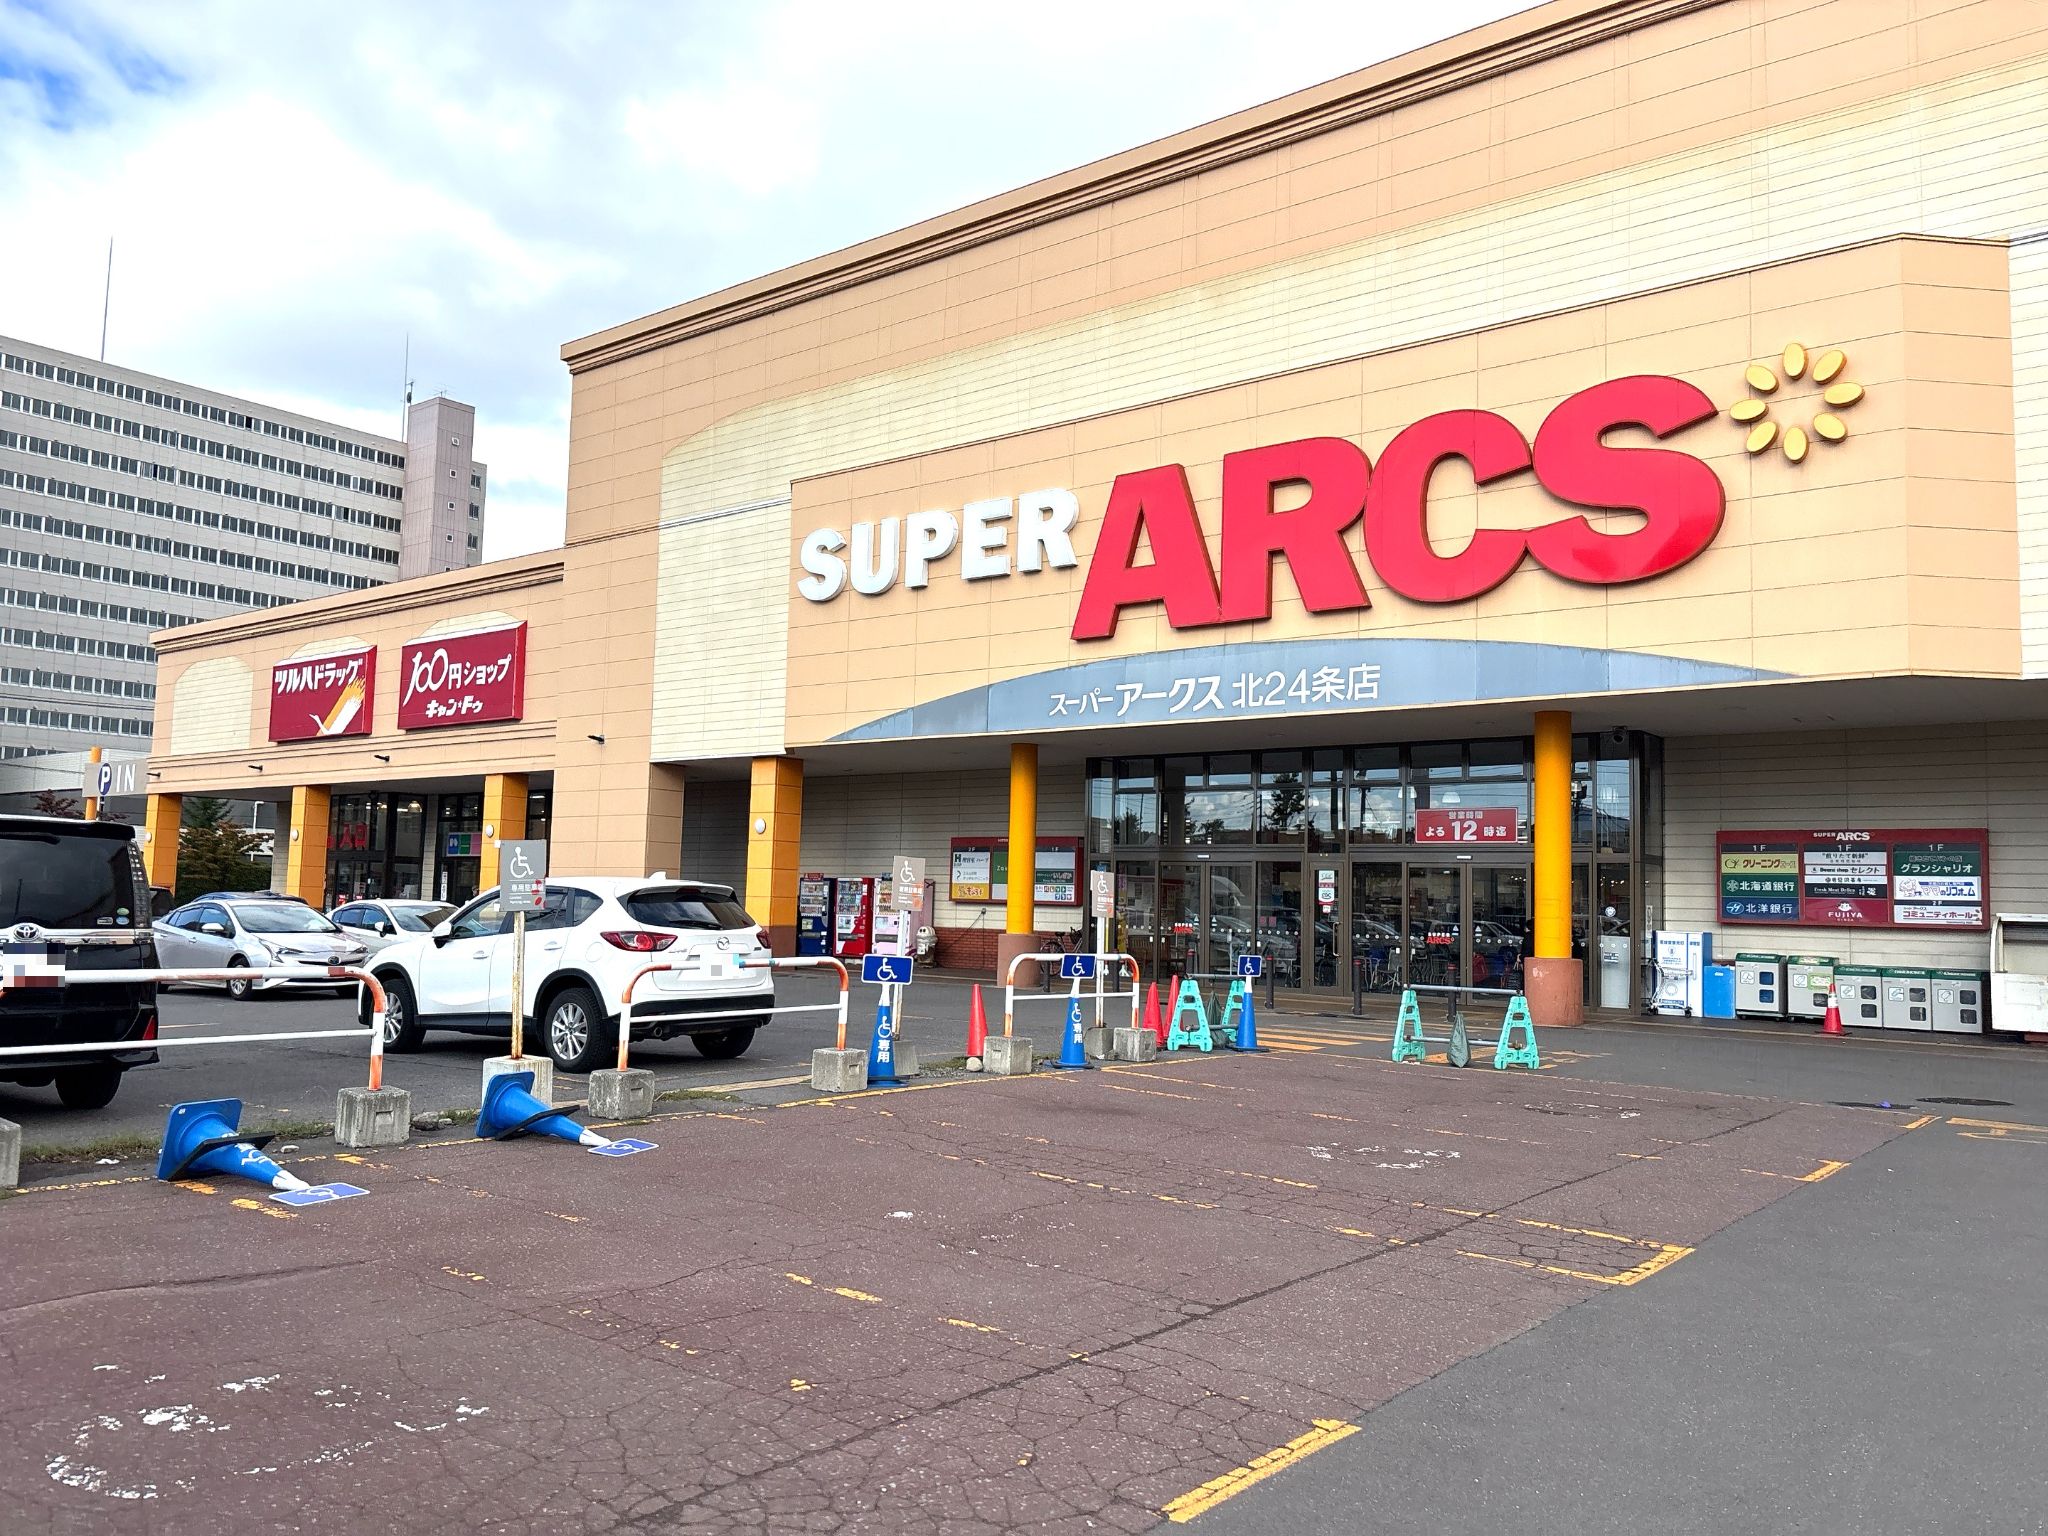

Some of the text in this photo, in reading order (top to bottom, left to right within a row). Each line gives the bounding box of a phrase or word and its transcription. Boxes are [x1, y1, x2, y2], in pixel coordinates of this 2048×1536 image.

[797, 373, 1727, 641] SUPER ARCS
[275, 658, 363, 694] ツルハドラッグ
[402, 648, 512, 707] 100円ショップ
[1232, 662, 1380, 709] 北24条店
[116, 764, 136, 792] IN
[1836, 831, 1870, 841] ARCS
[1900, 863, 1973, 873] グランシャリオ
[1739, 881, 1795, 892] 北海道銀行
[1746, 903, 1792, 914] 北洋銀行
[1828, 911, 1863, 919] FUJIYA
[1903, 910, 1973, 919] コミュニティホール
[877, 1039, 890, 1064] 専用
